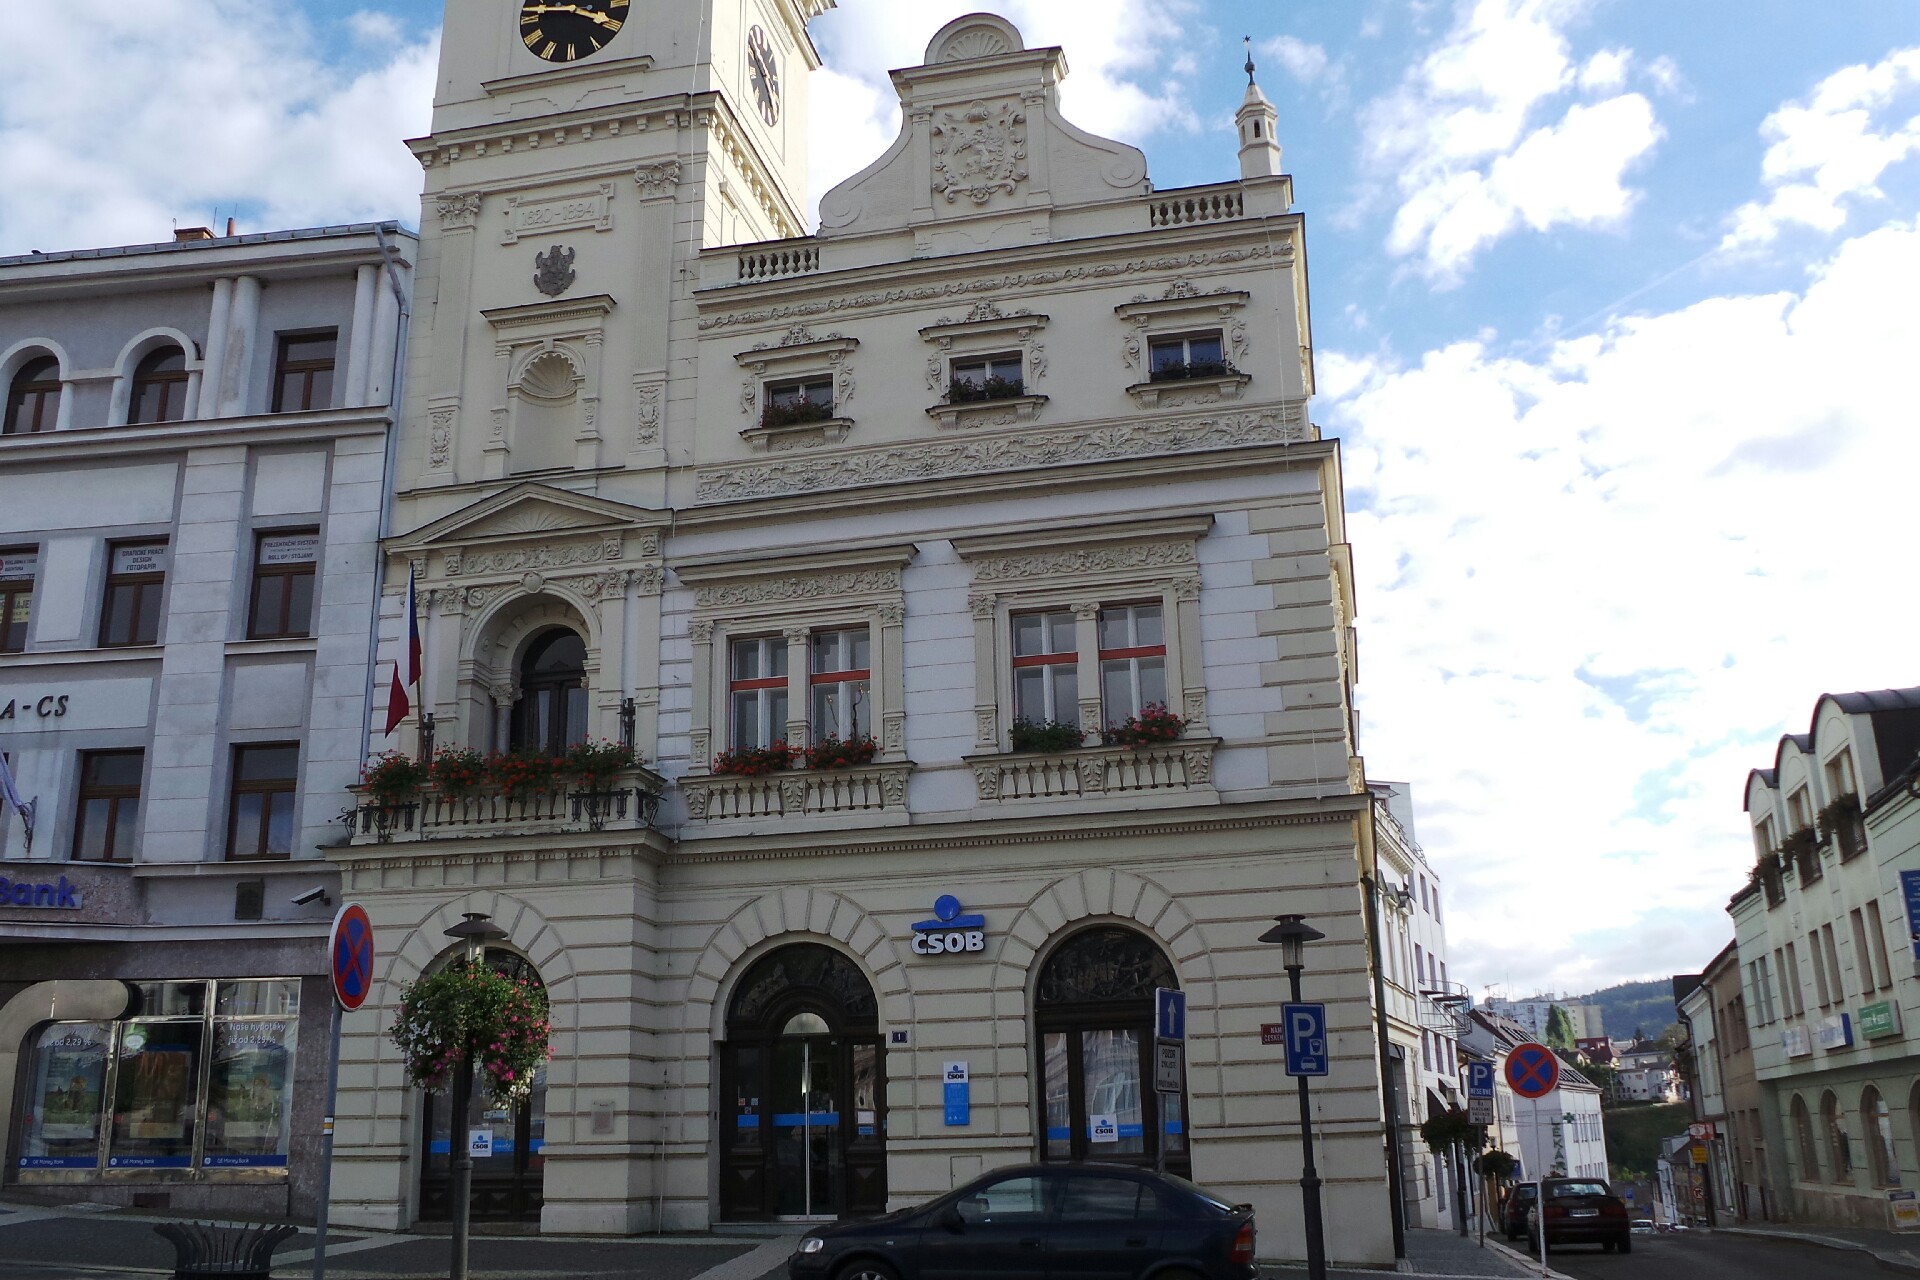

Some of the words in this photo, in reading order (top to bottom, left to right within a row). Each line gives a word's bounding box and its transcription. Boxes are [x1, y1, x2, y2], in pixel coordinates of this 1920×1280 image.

[911, 931, 984, 955] ČSOB
[239, 1035, 249, 1043] od
[1264, 1034, 1284, 1042] ČESKÉH
[1292, 1012, 1316, 1053] P
[65, 1038, 82, 1047] 2,29
[1473, 1065, 1488, 1086] P
